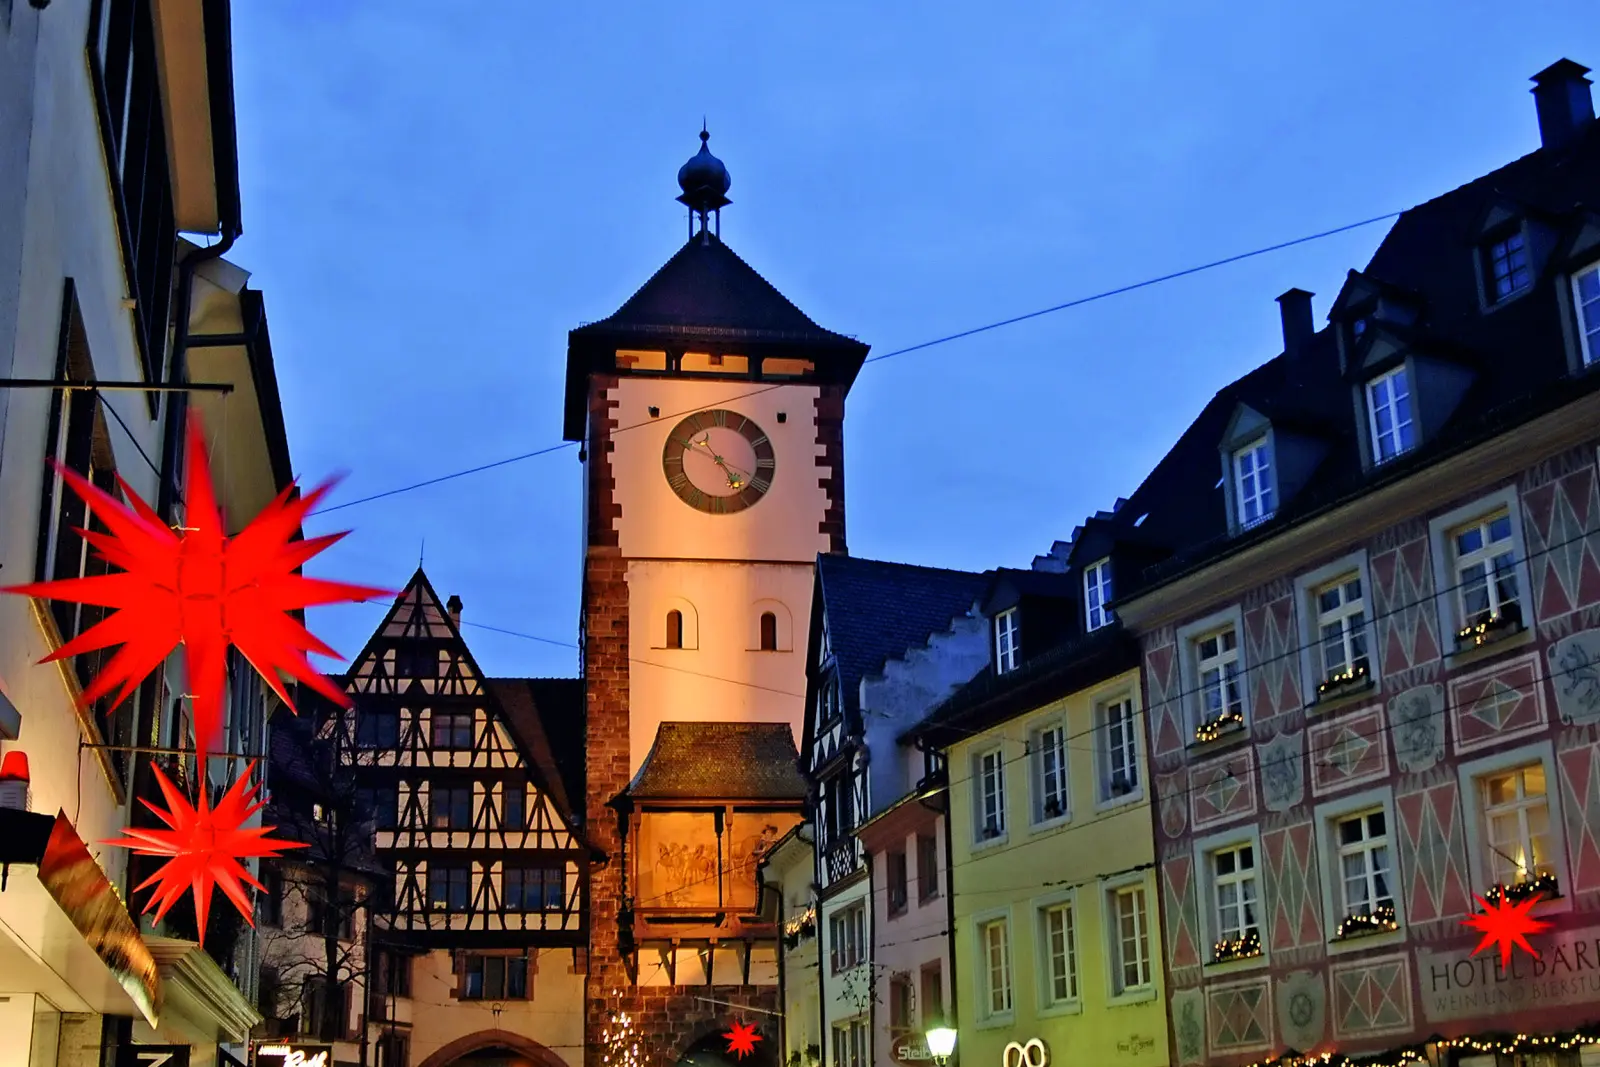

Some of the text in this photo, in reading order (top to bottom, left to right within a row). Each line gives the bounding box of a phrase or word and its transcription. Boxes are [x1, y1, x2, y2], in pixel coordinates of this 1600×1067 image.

[1430, 938, 1600, 992] HOTEL BÄR
[1434, 991, 1478, 1013] WEIN
